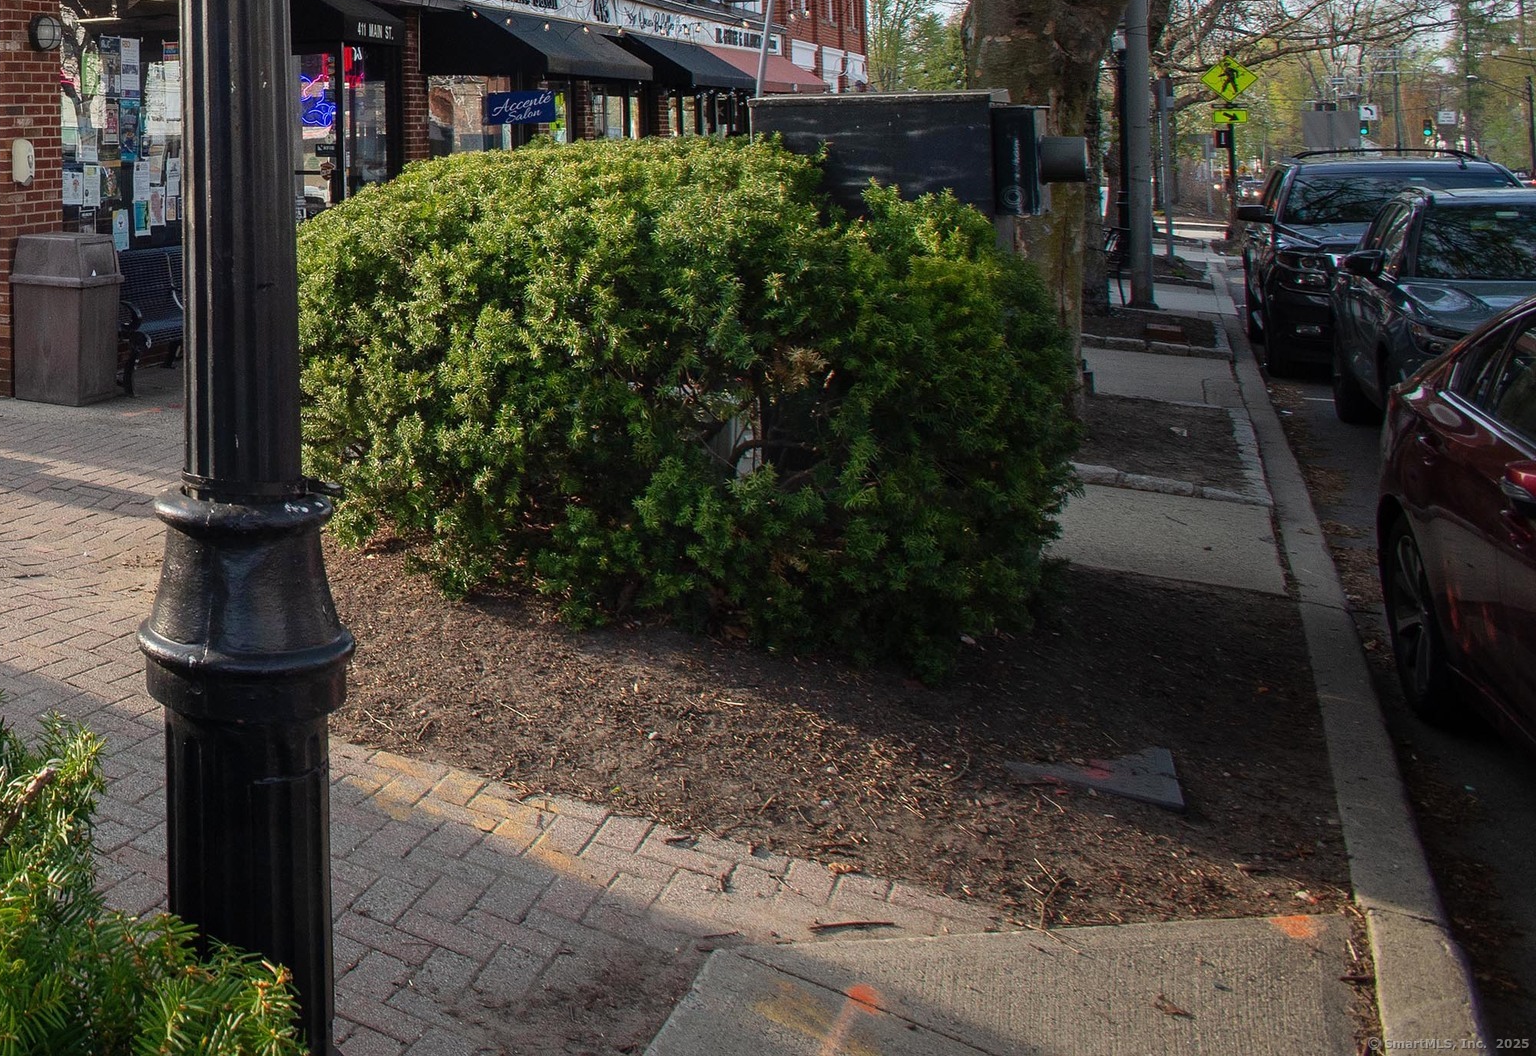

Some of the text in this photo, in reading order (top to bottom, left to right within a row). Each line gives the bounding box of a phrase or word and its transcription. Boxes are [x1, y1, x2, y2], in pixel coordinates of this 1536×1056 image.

[357, 22, 394, 40] 411 MAIN ST.
[492, 91, 553, 116] Accenté
[505, 107, 542, 123] Salon
